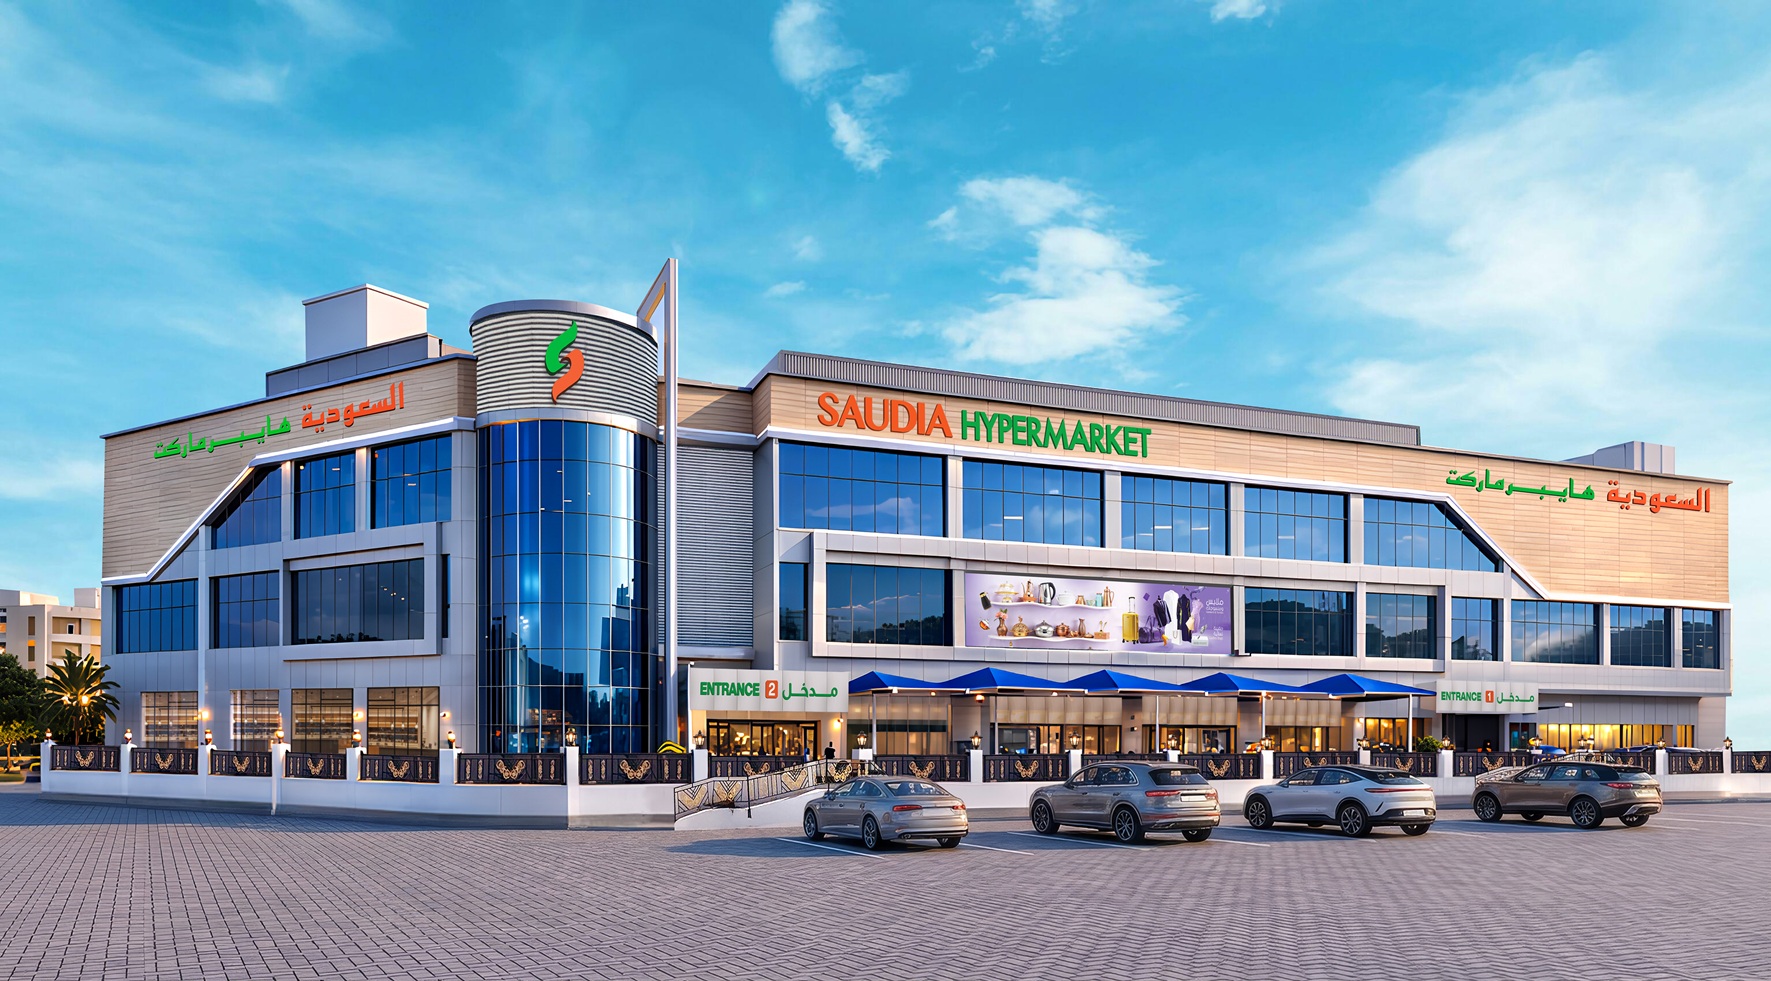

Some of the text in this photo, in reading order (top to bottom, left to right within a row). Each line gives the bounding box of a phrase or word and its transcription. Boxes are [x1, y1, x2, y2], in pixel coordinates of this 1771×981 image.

[301, 381, 405, 434] السعودية
[817, 392, 1152, 458] SAUDIA HYPERMARKET
[1606, 479, 1711, 514] السعودية
[700, 681, 776, 697] ENTRANCE 2
[782, 682, 839, 701] مدخل
[1441, 691, 1482, 702] ENTRANCE
[1496, 692, 1535, 705] مدخل
